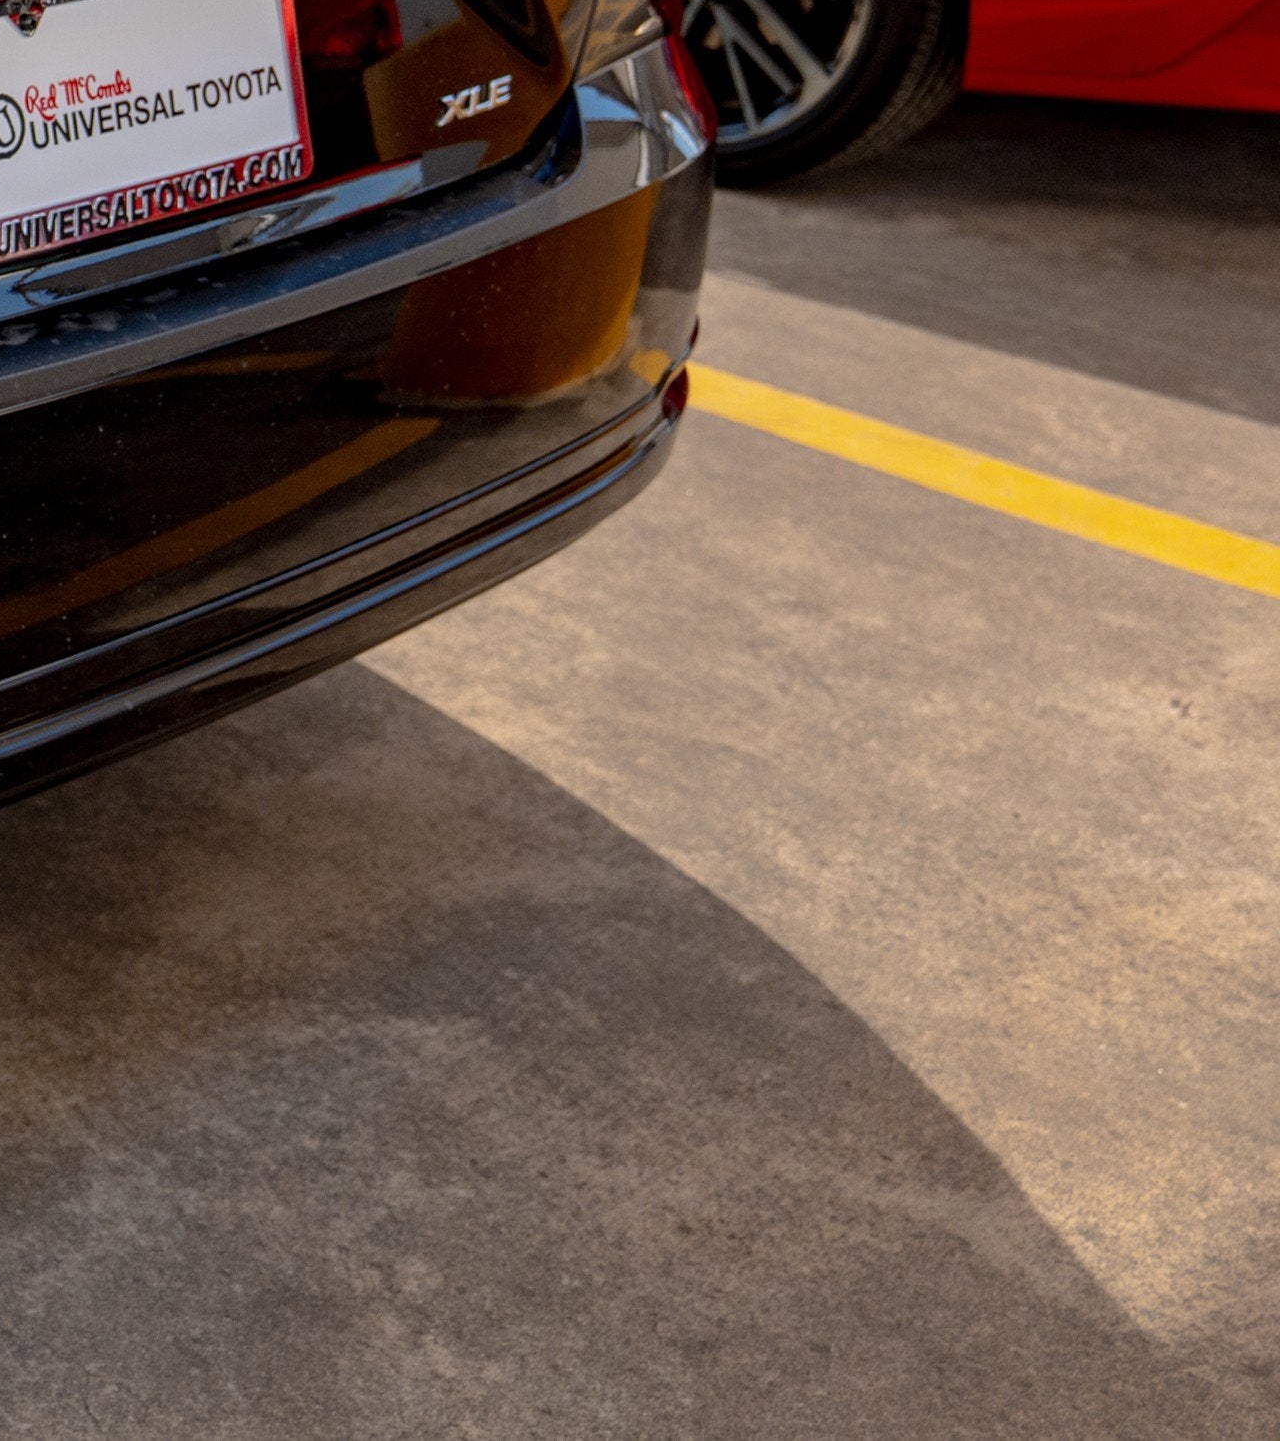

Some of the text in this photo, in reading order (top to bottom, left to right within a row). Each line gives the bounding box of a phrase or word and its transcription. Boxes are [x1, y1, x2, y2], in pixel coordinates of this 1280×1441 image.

[25, 70, 132, 122] Red McCombs
[30, 65, 283, 149] UNIVERSAL TOYOTA
[437, 74, 513, 127] XLE
